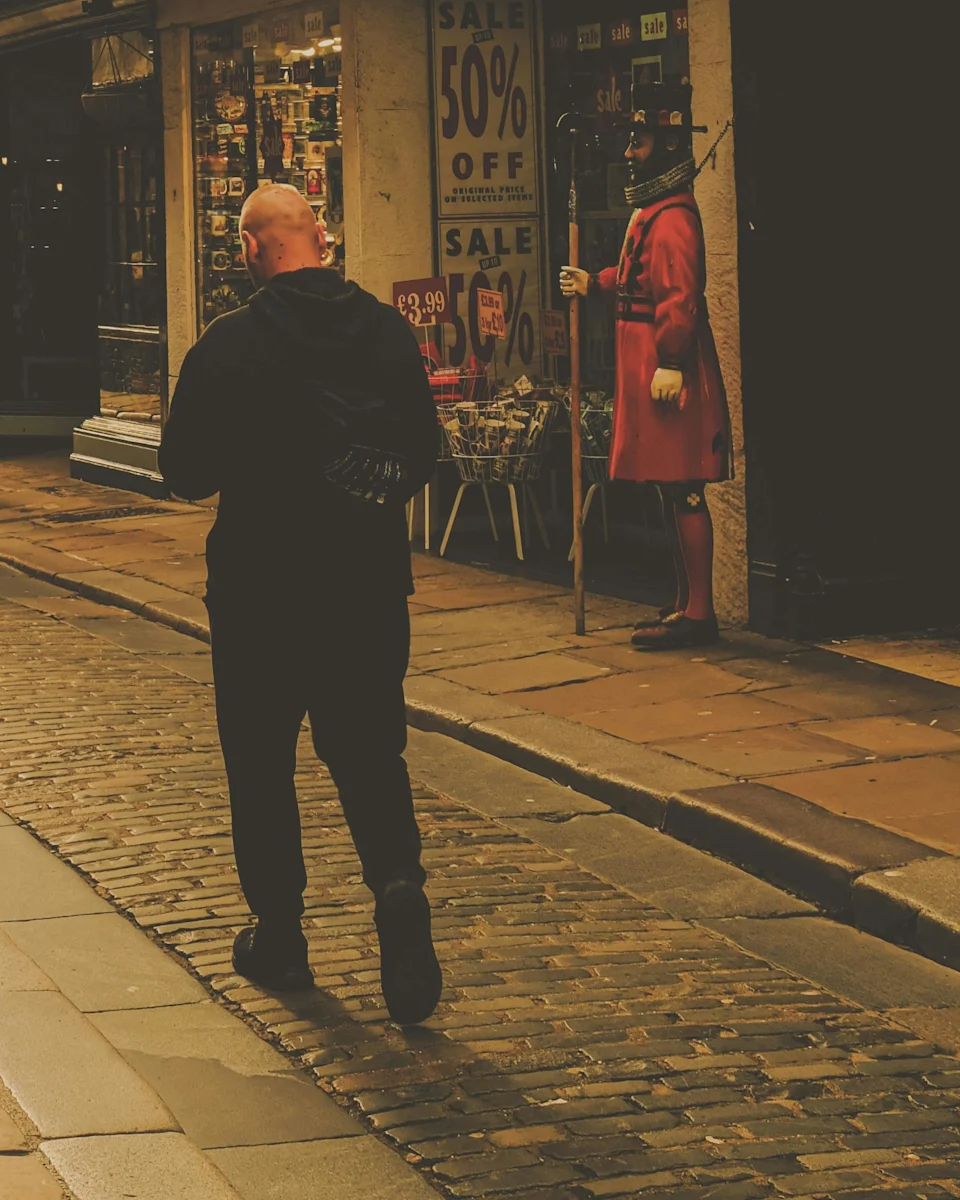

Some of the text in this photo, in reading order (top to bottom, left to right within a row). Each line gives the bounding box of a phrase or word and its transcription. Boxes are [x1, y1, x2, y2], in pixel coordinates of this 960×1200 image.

[307, 16, 321, 32] sale
[438, 1, 525, 30] SALE
[644, 17, 664, 35] sale
[580, 27, 599, 44] sale
[611, 23, 631, 40] sale
[441, 42, 527, 140] 50%
[597, 75, 622, 113] sale
[452, 152, 523, 181] OFF
[444, 193, 533, 203] ON SELECTED ITEMS
[452, 185, 525, 195] ORIGINAL PRICE
[445, 227, 532, 257] SALE
[397, 290, 445, 325] £3.99
[448, 269, 534, 368] 50%
